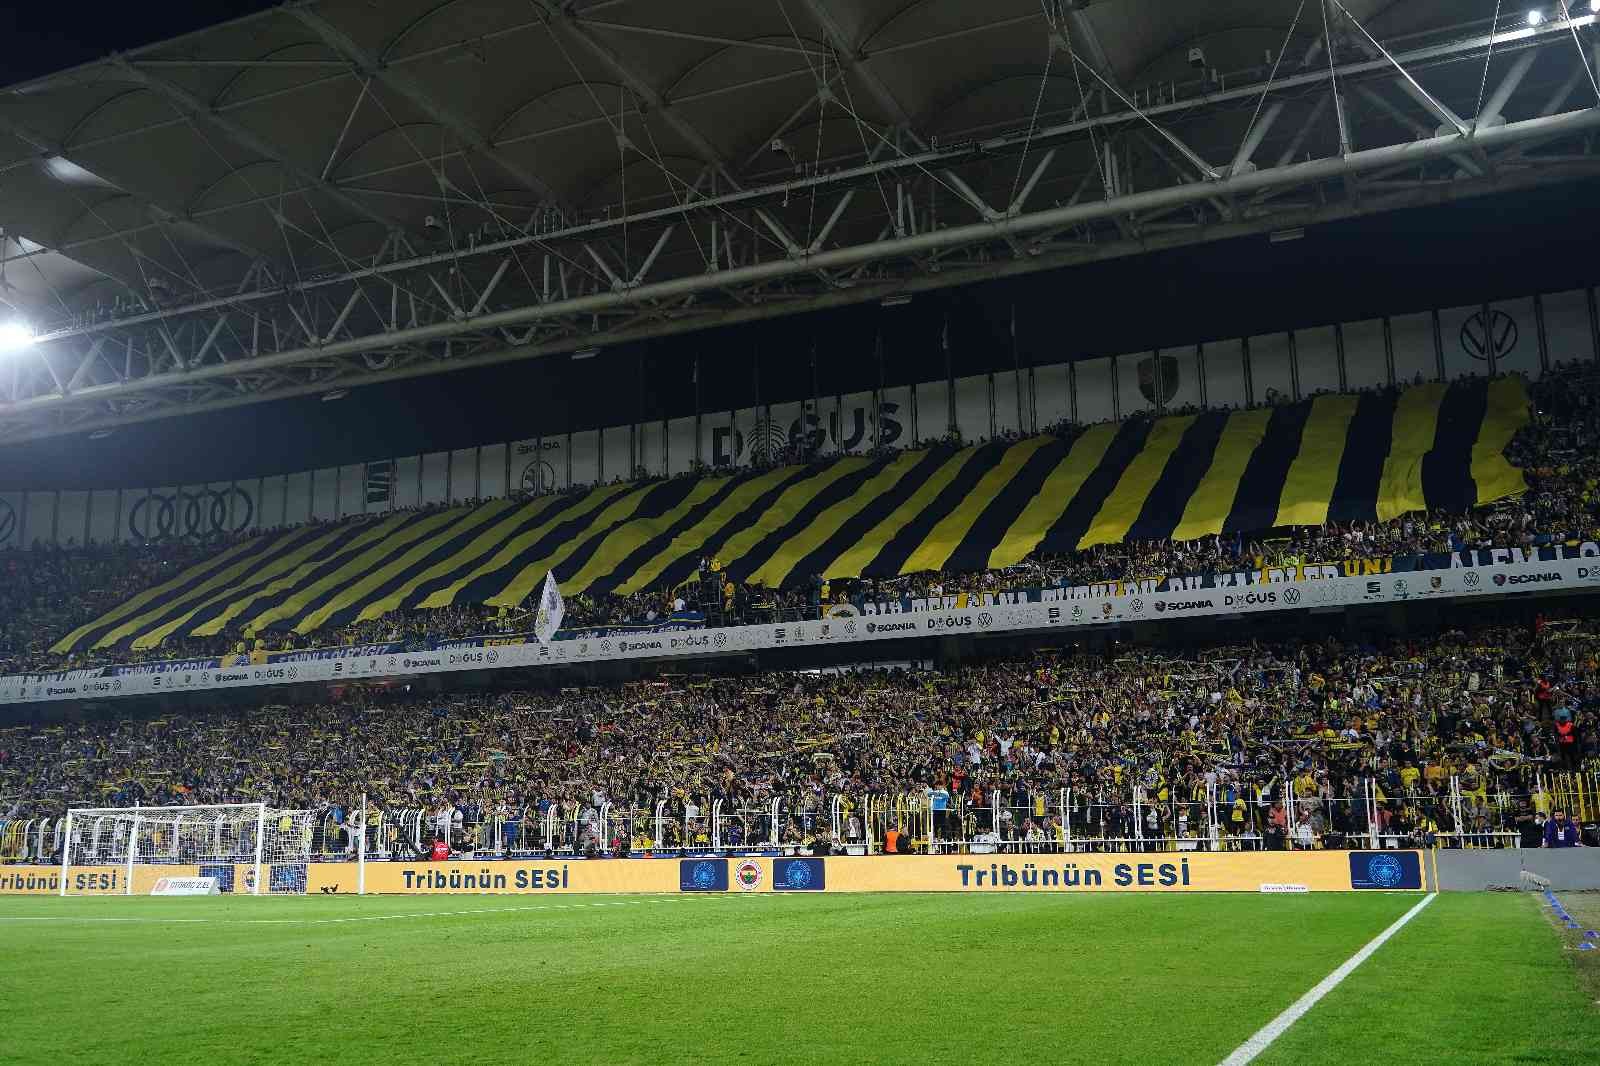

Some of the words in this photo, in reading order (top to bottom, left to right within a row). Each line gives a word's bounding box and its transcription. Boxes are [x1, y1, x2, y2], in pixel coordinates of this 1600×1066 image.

[1508, 572, 1562, 584] SCANIA
[1167, 600, 1213, 612] SCANIA
[76, 868, 116, 890] SESİ
[402, 868, 507, 889] Tribünün
[514, 864, 569, 889] SESİ
[956, 863, 1102, 887] Tribünün
[1114, 858, 1191, 887] SESİ
